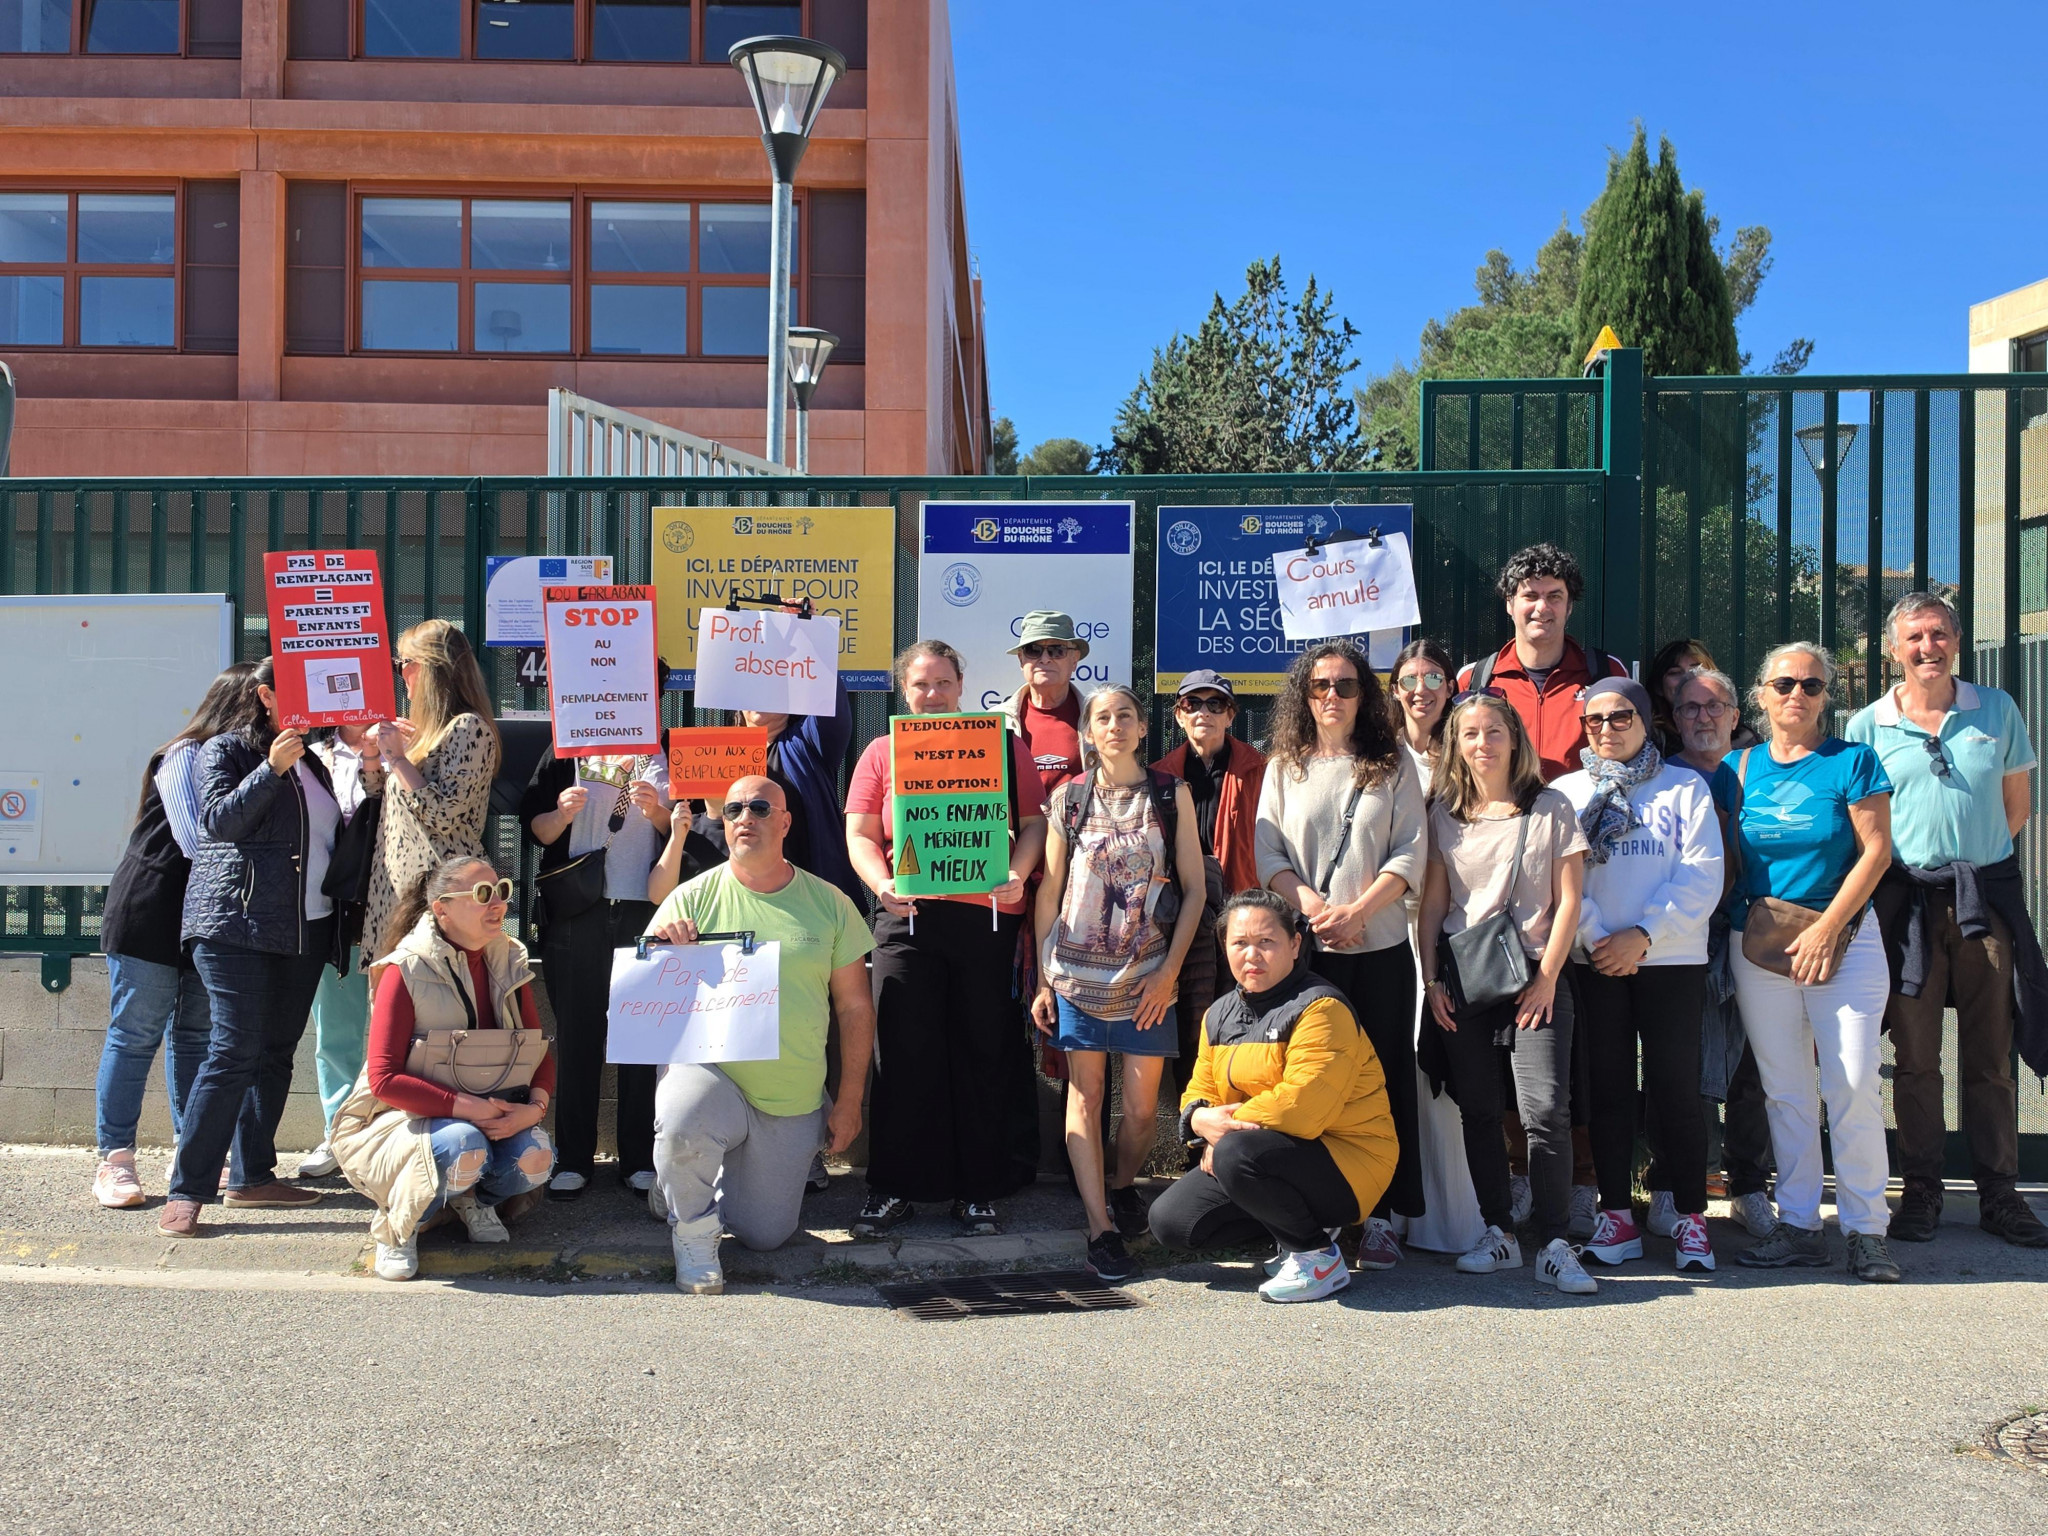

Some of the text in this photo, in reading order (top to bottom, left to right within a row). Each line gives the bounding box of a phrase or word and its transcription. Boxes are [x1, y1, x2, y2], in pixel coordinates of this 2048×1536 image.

[288, 557, 345, 568] PAS DE
[686, 555, 859, 574] ICI, LE DÉPARTEMENT
[1198, 561, 1226, 576] ICI,
[1230, 561, 1246, 575] LE
[1286, 557, 1355, 582] Cours
[275, 573, 372, 585] REMPLAÇANT
[546, 586, 647, 601] LOU GARLABAN
[686, 578, 859, 599] INVESTIT POUR
[1199, 579, 1277, 600] INVEST
[1307, 577, 1380, 610] annulé
[285, 605, 370, 617] PARENTS ET
[564, 607, 639, 627] STOP
[1199, 607, 1231, 631] LA
[298, 620, 361, 632] ENFANTS
[710, 614, 765, 645] Prof.
[281, 636, 379, 650] MECONTENTS
[594, 639, 611, 649] AU
[1198, 636, 1235, 654] DES
[590, 657, 617, 667] NON
[734, 651, 817, 680] absent
[1069, 664, 1109, 682] ou
[561, 692, 648, 704] REMPLACEMENT
[322, 713, 336, 723] Lou
[595, 711, 616, 720] DES
[570, 726, 643, 738] ENSEIGNANTS
[901, 719, 997, 732] L'EDUCATION
[694, 745, 747, 757] OUI AUX
[914, 749, 986, 760] N'EST PAS
[904, 780, 934, 790] UNE
[936, 778, 991, 789] OPTION
[906, 803, 1008, 822] NOS ENFANTS
[924, 829, 995, 849] MÉRITENT
[1611, 840, 1665, 857] FORNIA
[930, 855, 988, 882] MIEUX
[657, 957, 749, 986] Pas de
[619, 984, 779, 1028] remplacement
